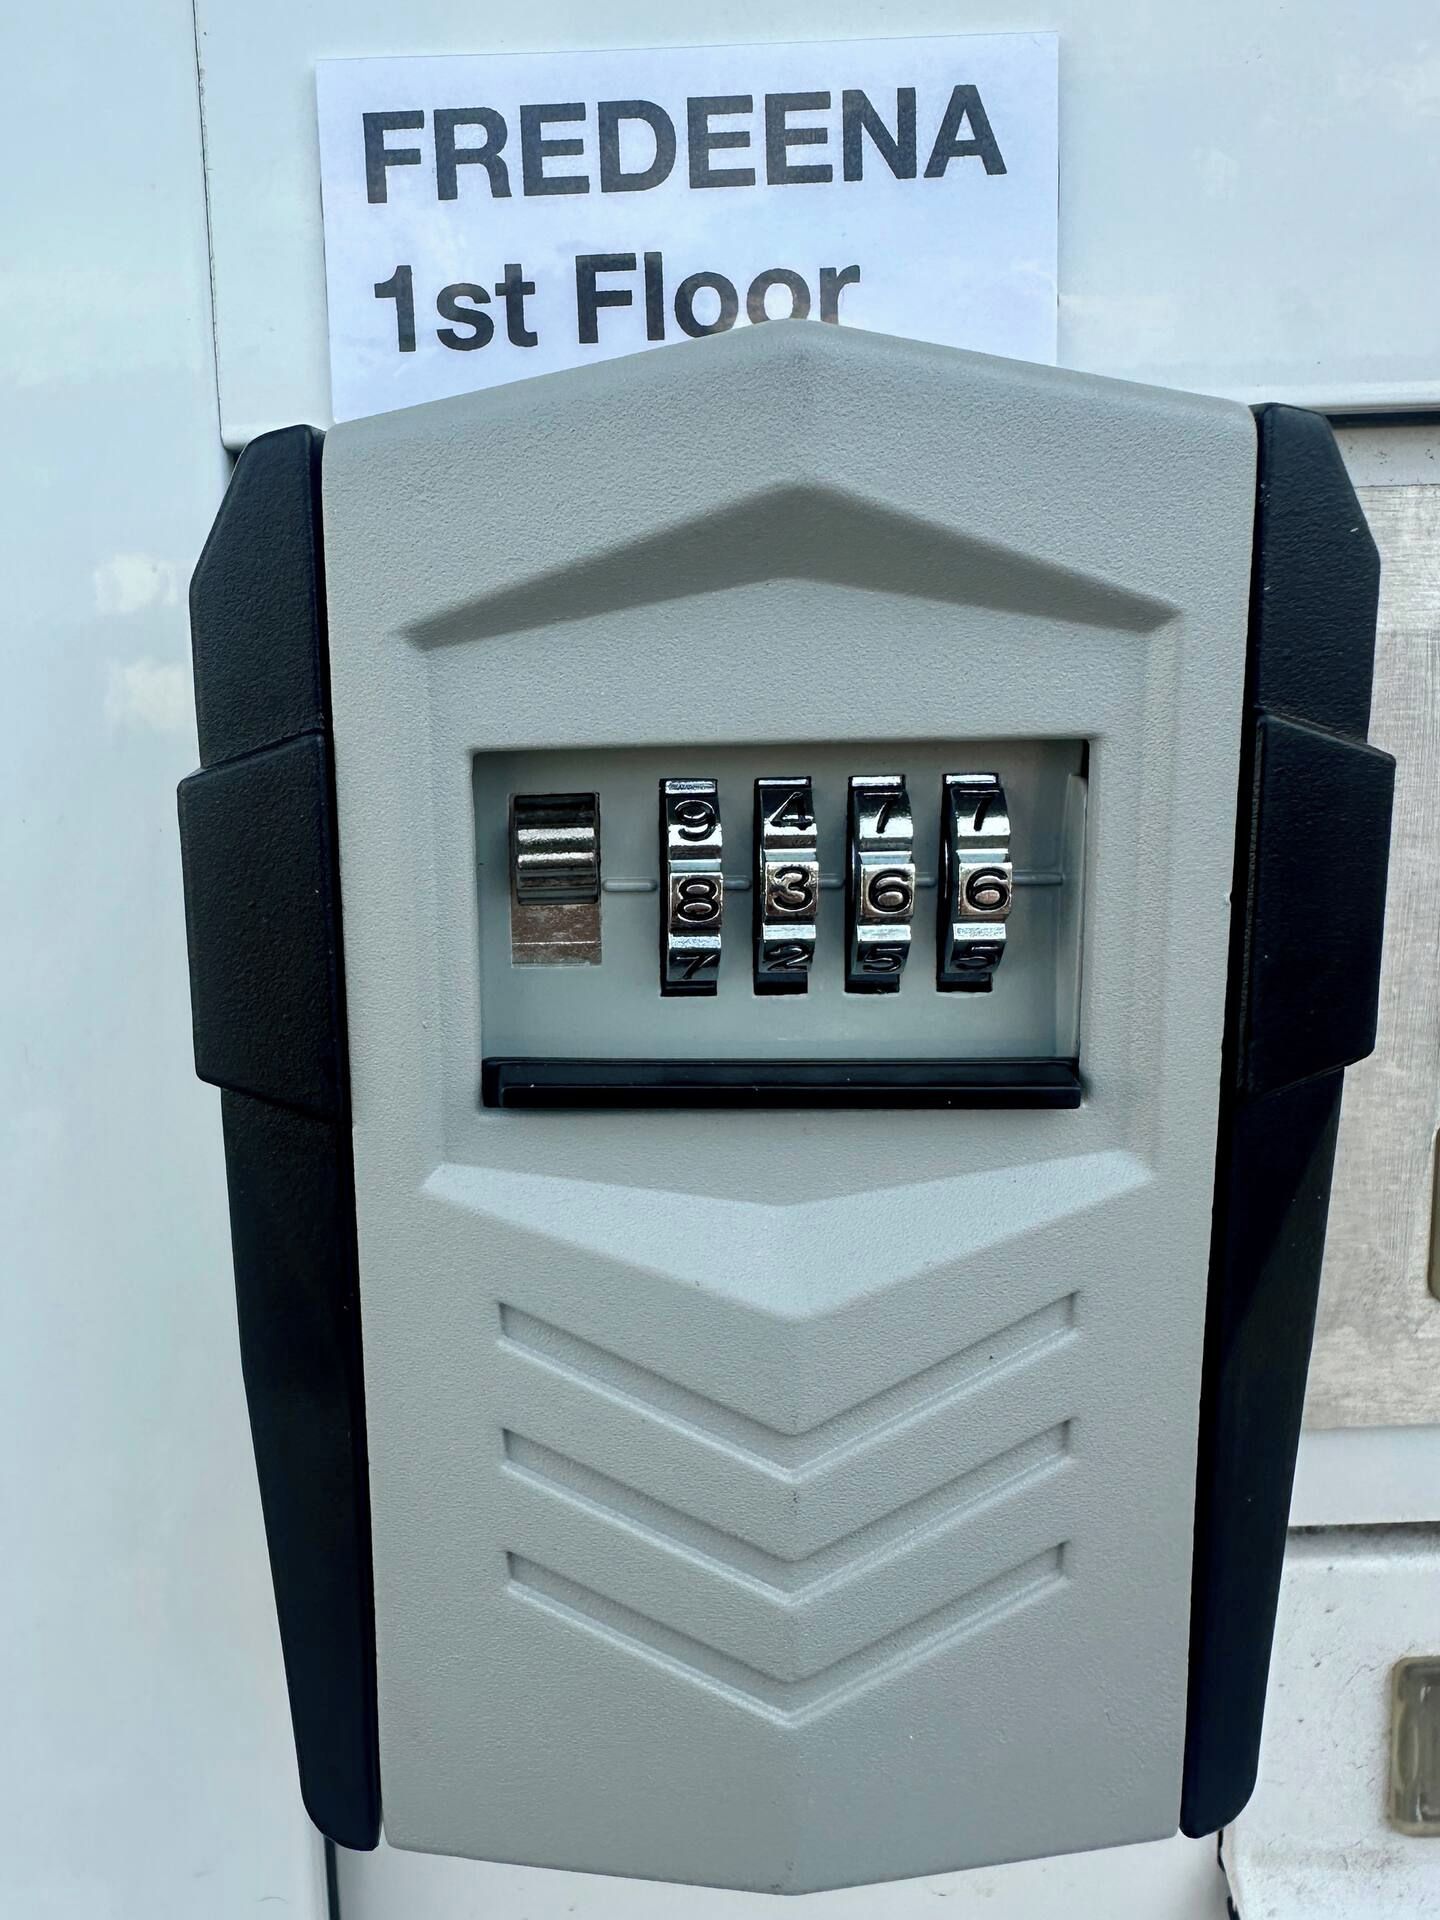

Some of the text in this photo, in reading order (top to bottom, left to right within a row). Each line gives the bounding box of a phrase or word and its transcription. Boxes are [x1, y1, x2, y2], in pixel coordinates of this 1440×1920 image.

[363, 84, 1007, 204] FREDEENA
[374, 252, 861, 352] 1st Floor
[677, 866, 1010, 922] 8 3 6 6
